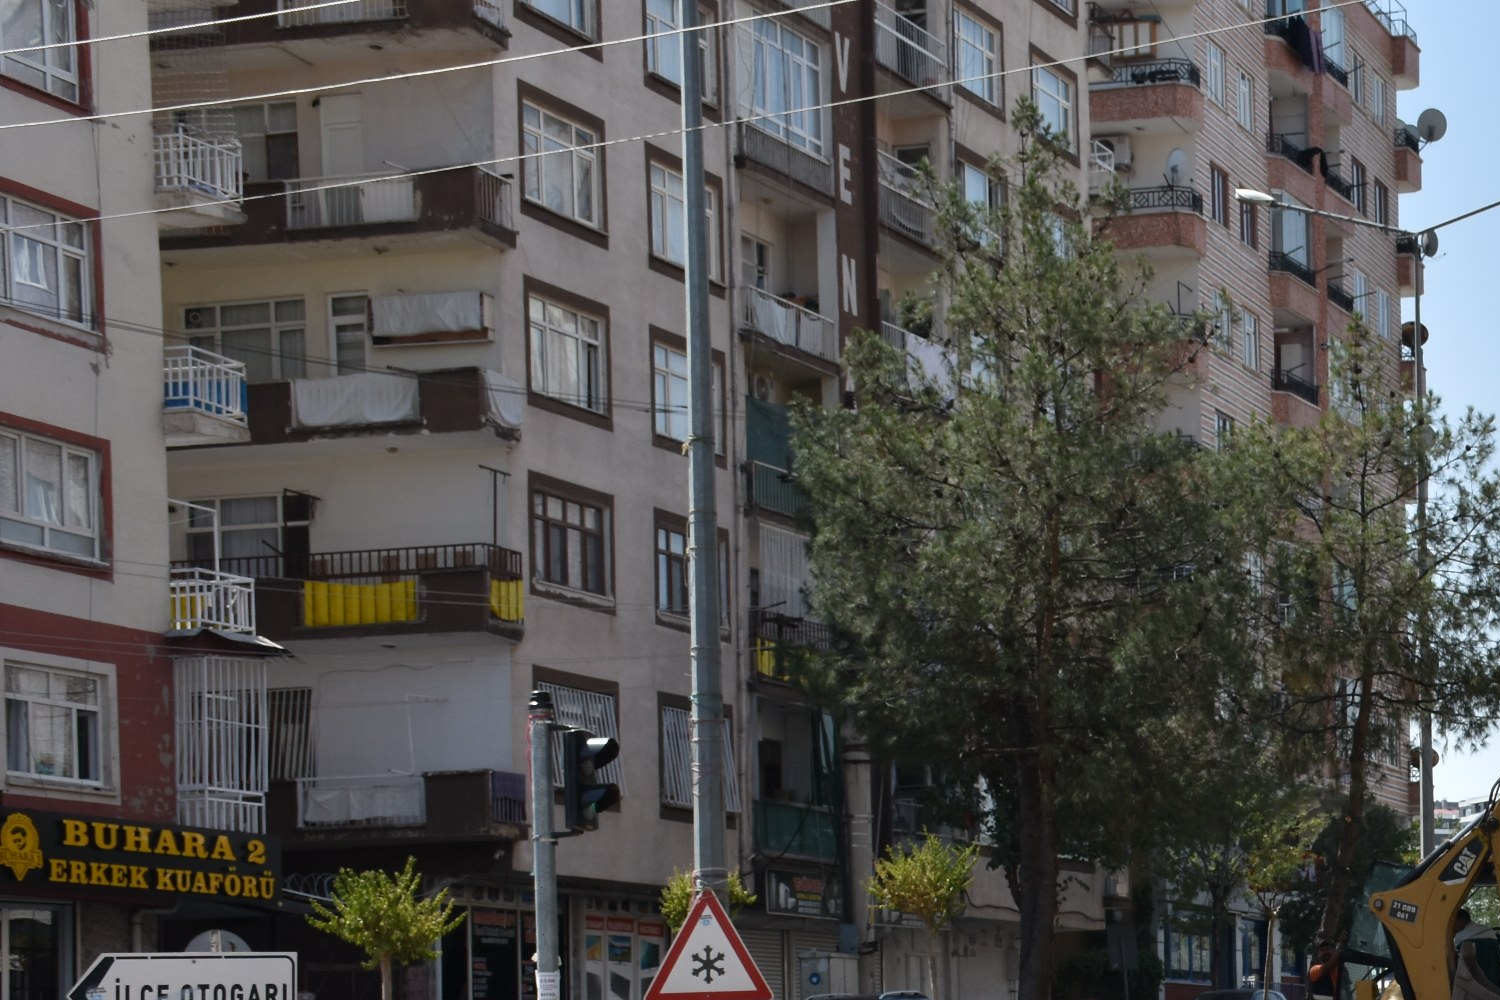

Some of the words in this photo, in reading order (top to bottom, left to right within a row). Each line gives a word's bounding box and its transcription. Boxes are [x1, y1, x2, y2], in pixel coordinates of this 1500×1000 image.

[62, 819, 236, 861] BUHARA
[247, 839, 266, 865] 2
[49, 858, 149, 889] ERKEK
[156, 865, 275, 899] KUAFÖRÜ
[1453, 847, 1477, 876] CAT
[1392, 901, 1401, 909] 21
